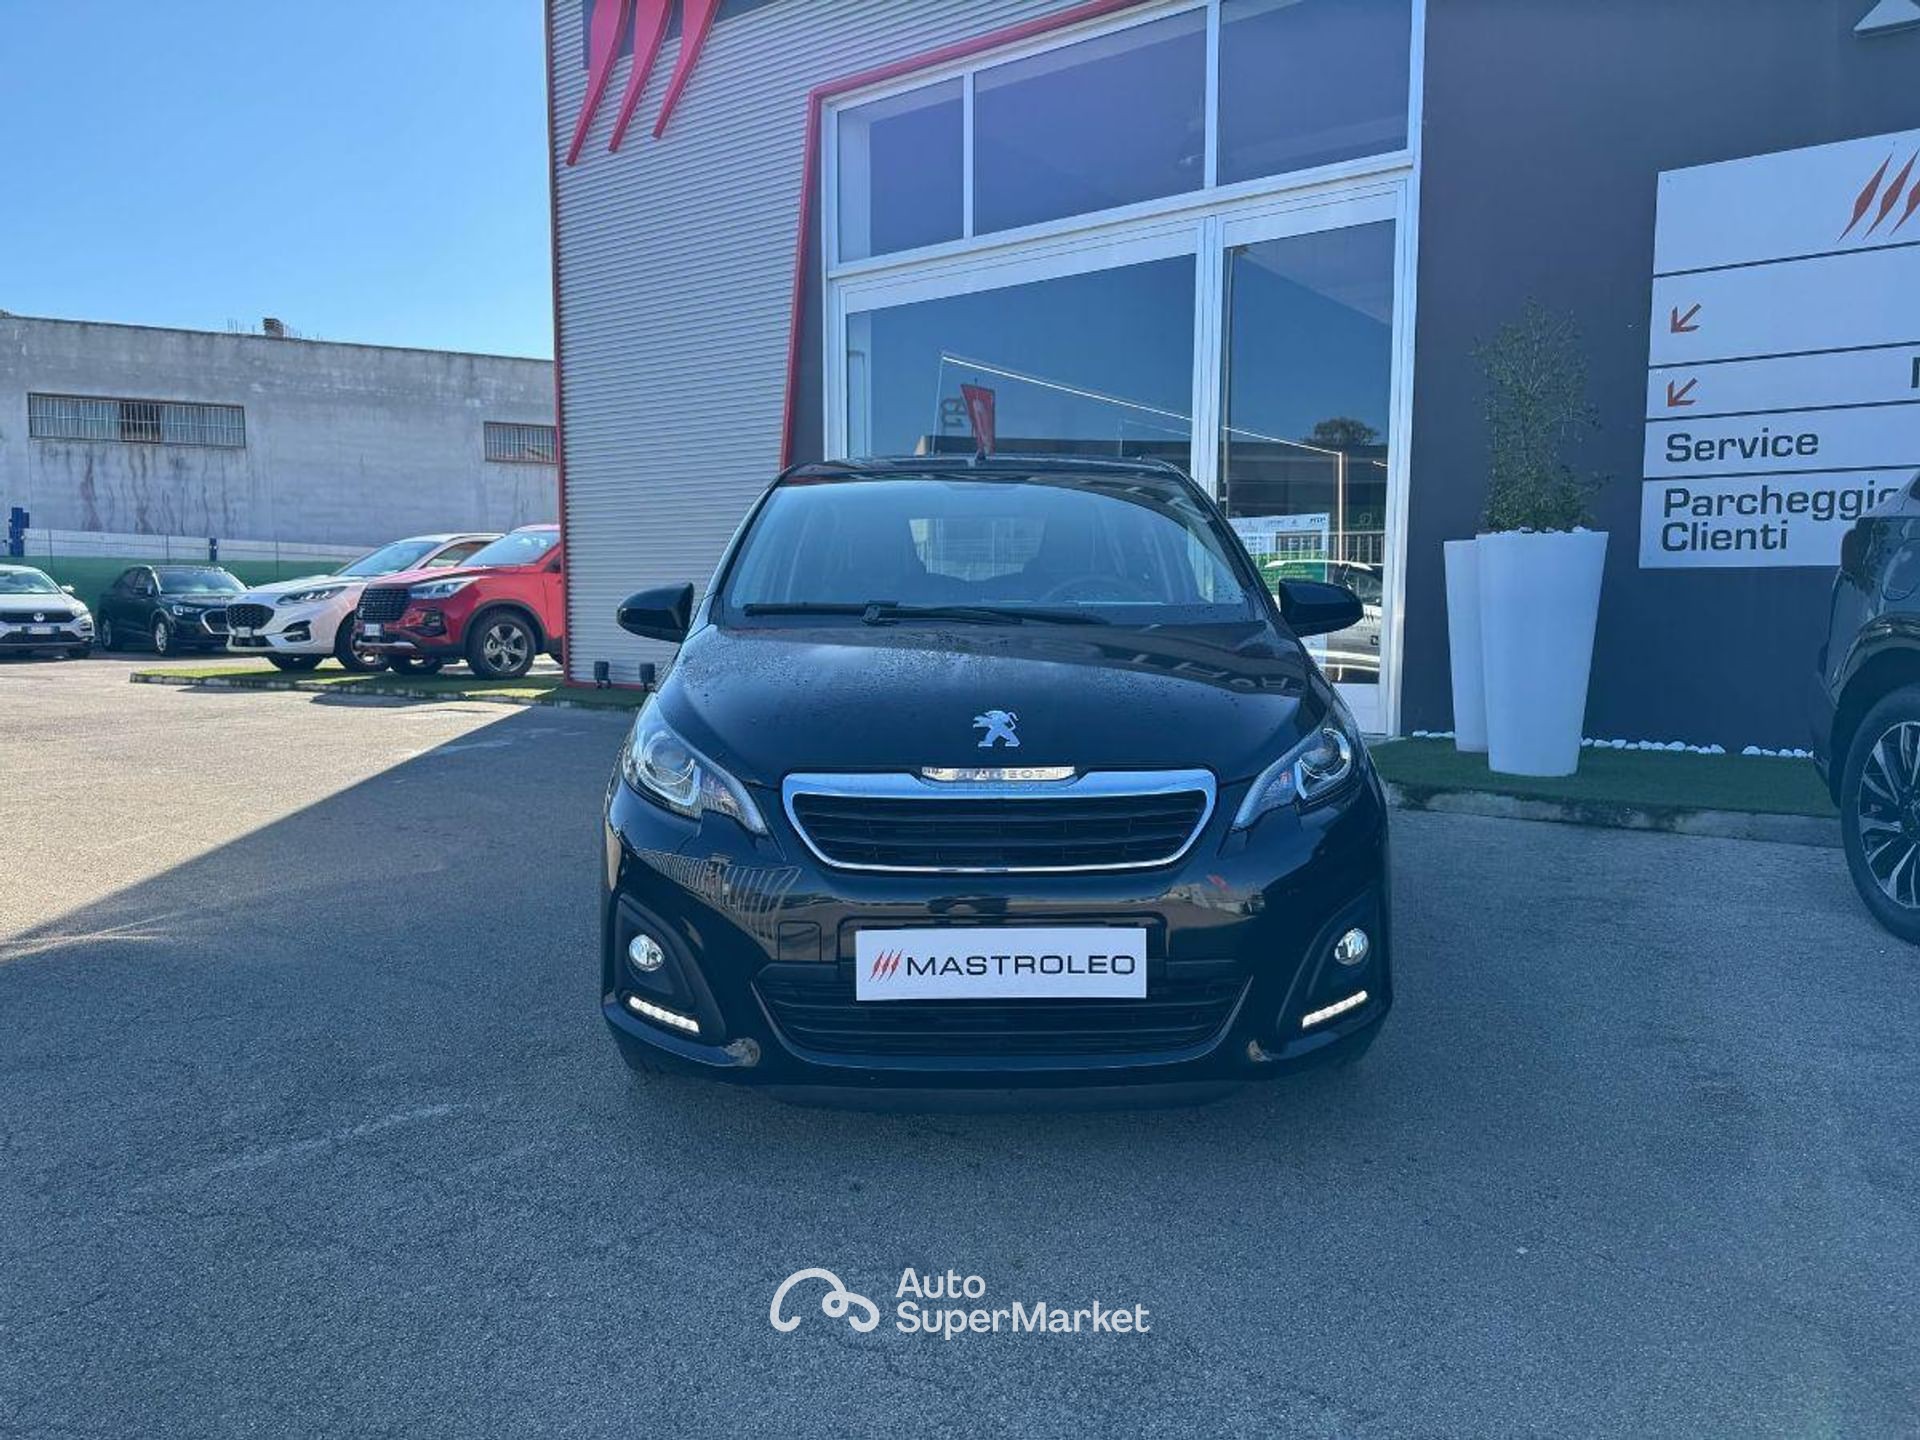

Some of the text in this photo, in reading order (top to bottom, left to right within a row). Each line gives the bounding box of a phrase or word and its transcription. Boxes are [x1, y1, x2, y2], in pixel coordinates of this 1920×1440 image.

[1665, 427, 1819, 462] Service
[1661, 520, 1788, 551] Clienti
[906, 954, 1136, 976] MASTROLEO
